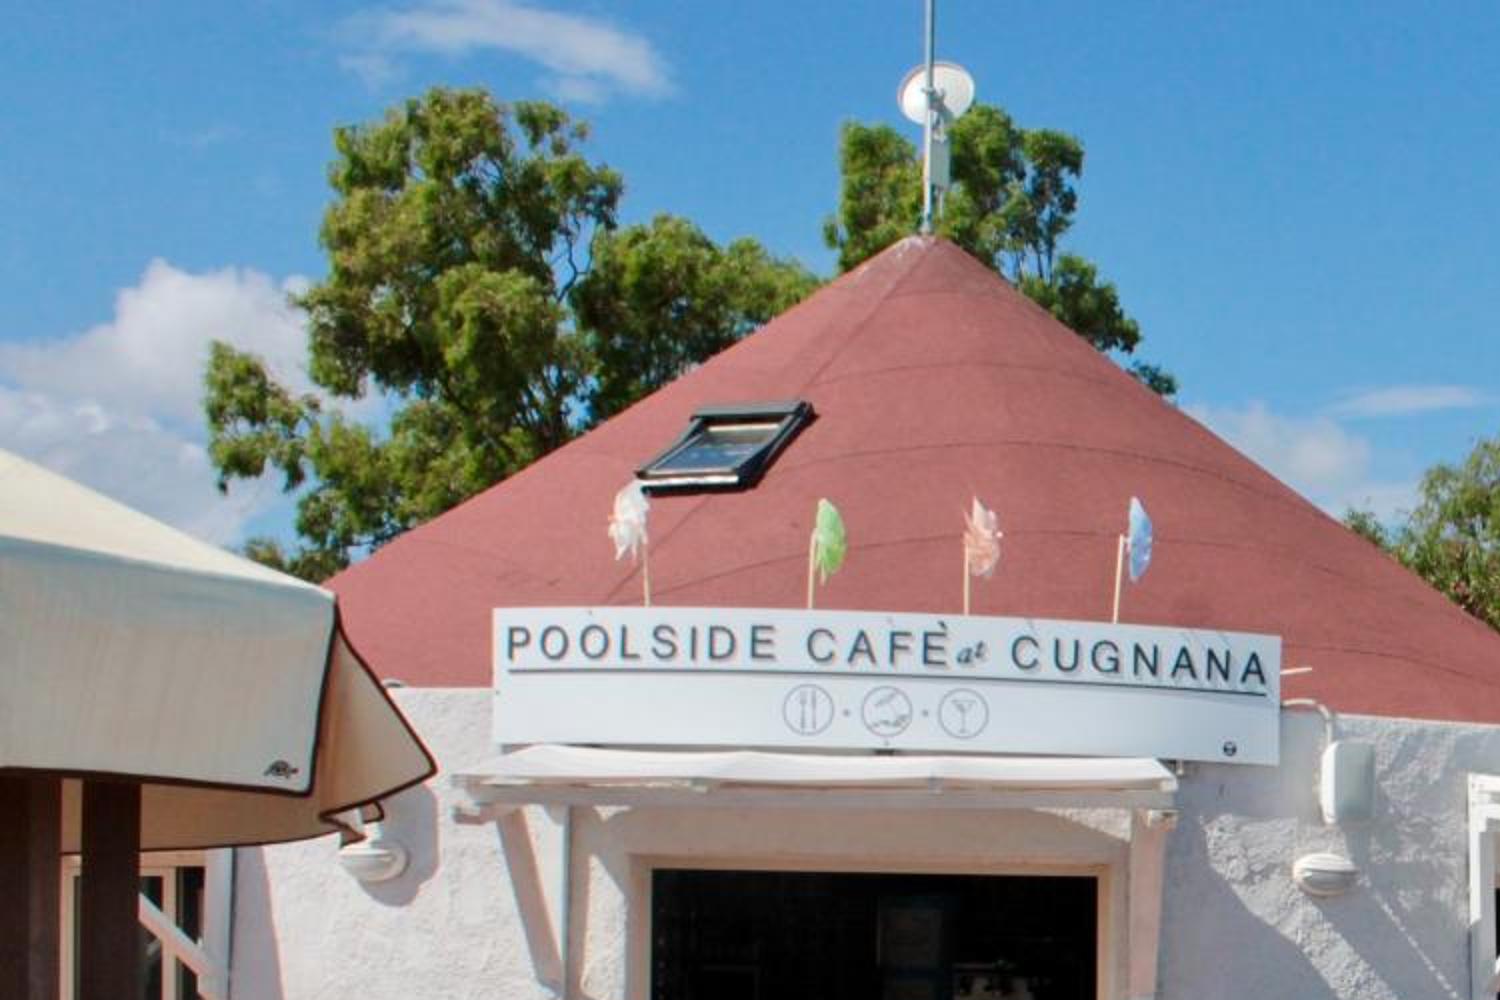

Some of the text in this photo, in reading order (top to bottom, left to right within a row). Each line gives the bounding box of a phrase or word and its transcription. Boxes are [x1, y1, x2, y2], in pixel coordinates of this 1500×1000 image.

[507, 620, 1267, 686] POOLSIDE CAFÈ at CUGNANA
